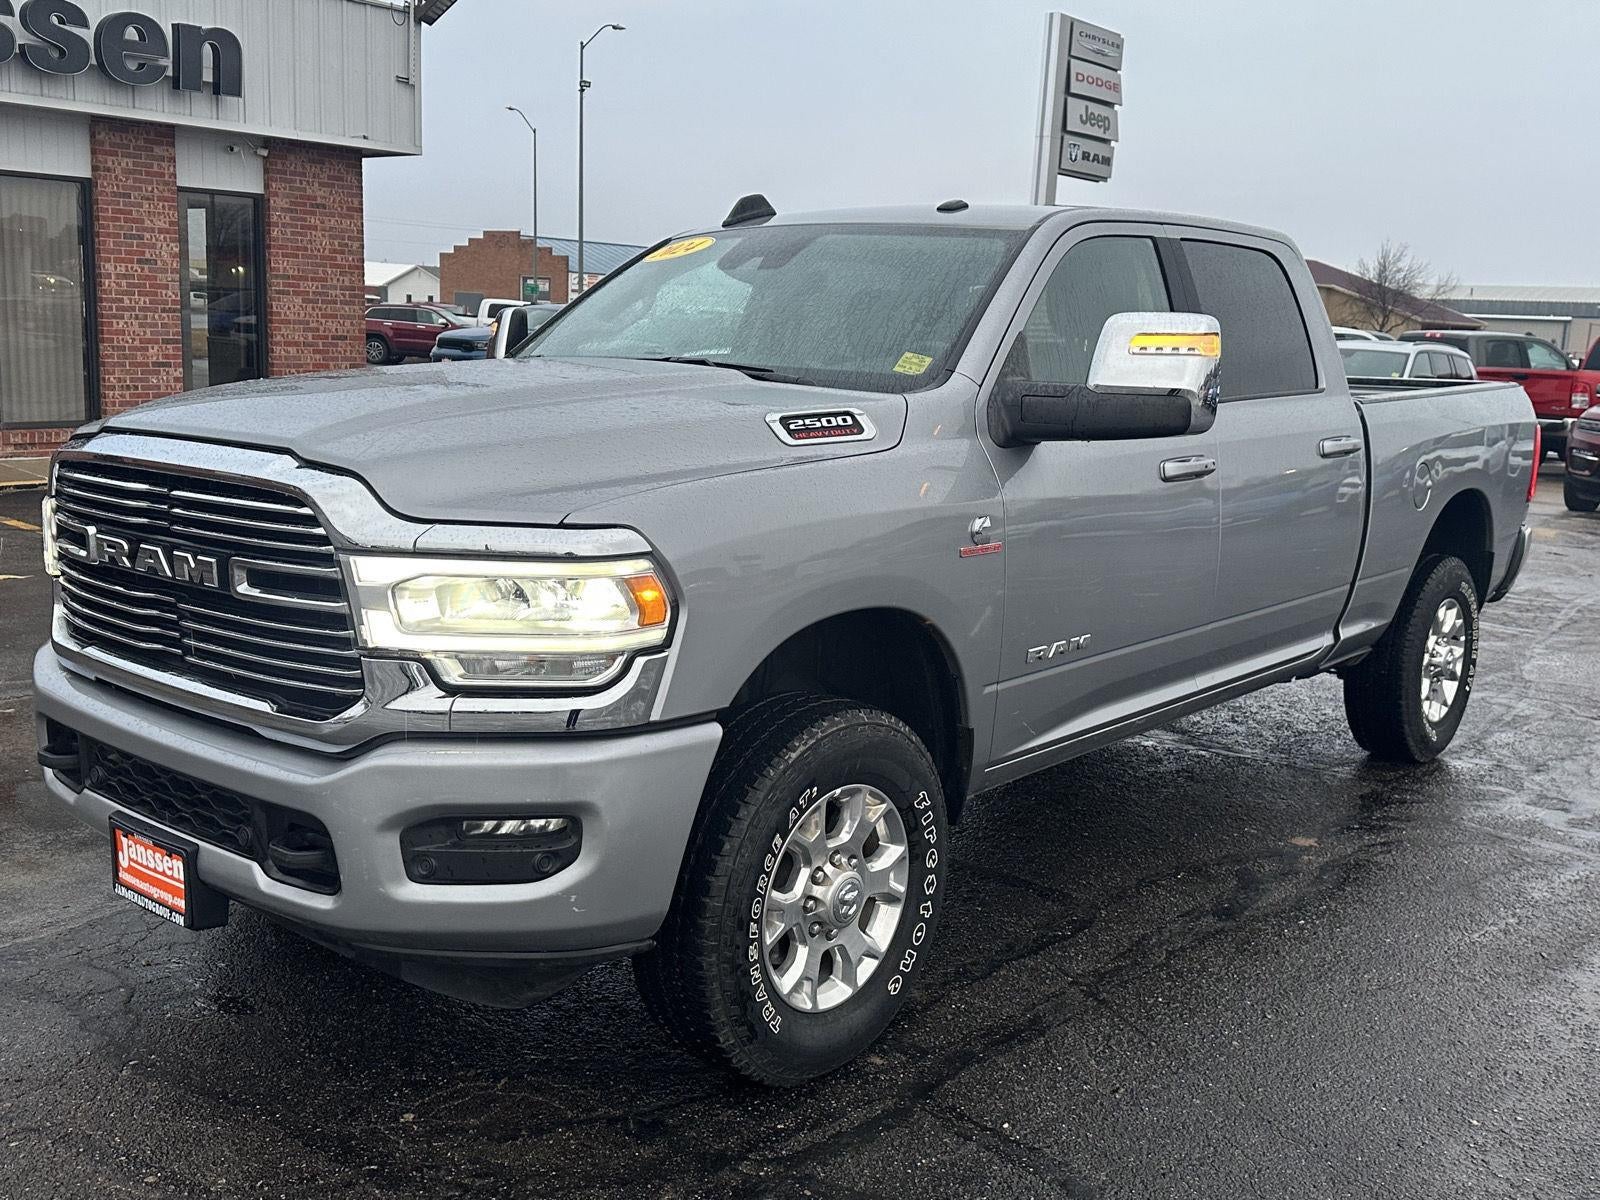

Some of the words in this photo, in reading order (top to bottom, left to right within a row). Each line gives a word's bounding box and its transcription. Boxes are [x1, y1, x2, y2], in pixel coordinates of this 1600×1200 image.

[0, 0, 243, 98] sen
[1079, 30, 1121, 49] CHRYSLER
[1075, 72, 1119, 93] DODGE
[1080, 105, 1110, 134] Jeep
[1081, 150, 1111, 167] RAM
[787, 415, 853, 430] 2500
[794, 429, 829, 439] HEAVY
[831, 427, 859, 436] DUTY
[97, 533, 219, 588] RAM
[1025, 633, 1092, 664] RAM
[119, 834, 185, 880] Janssen
[748, 832, 783, 1034] TRANSFORCE
